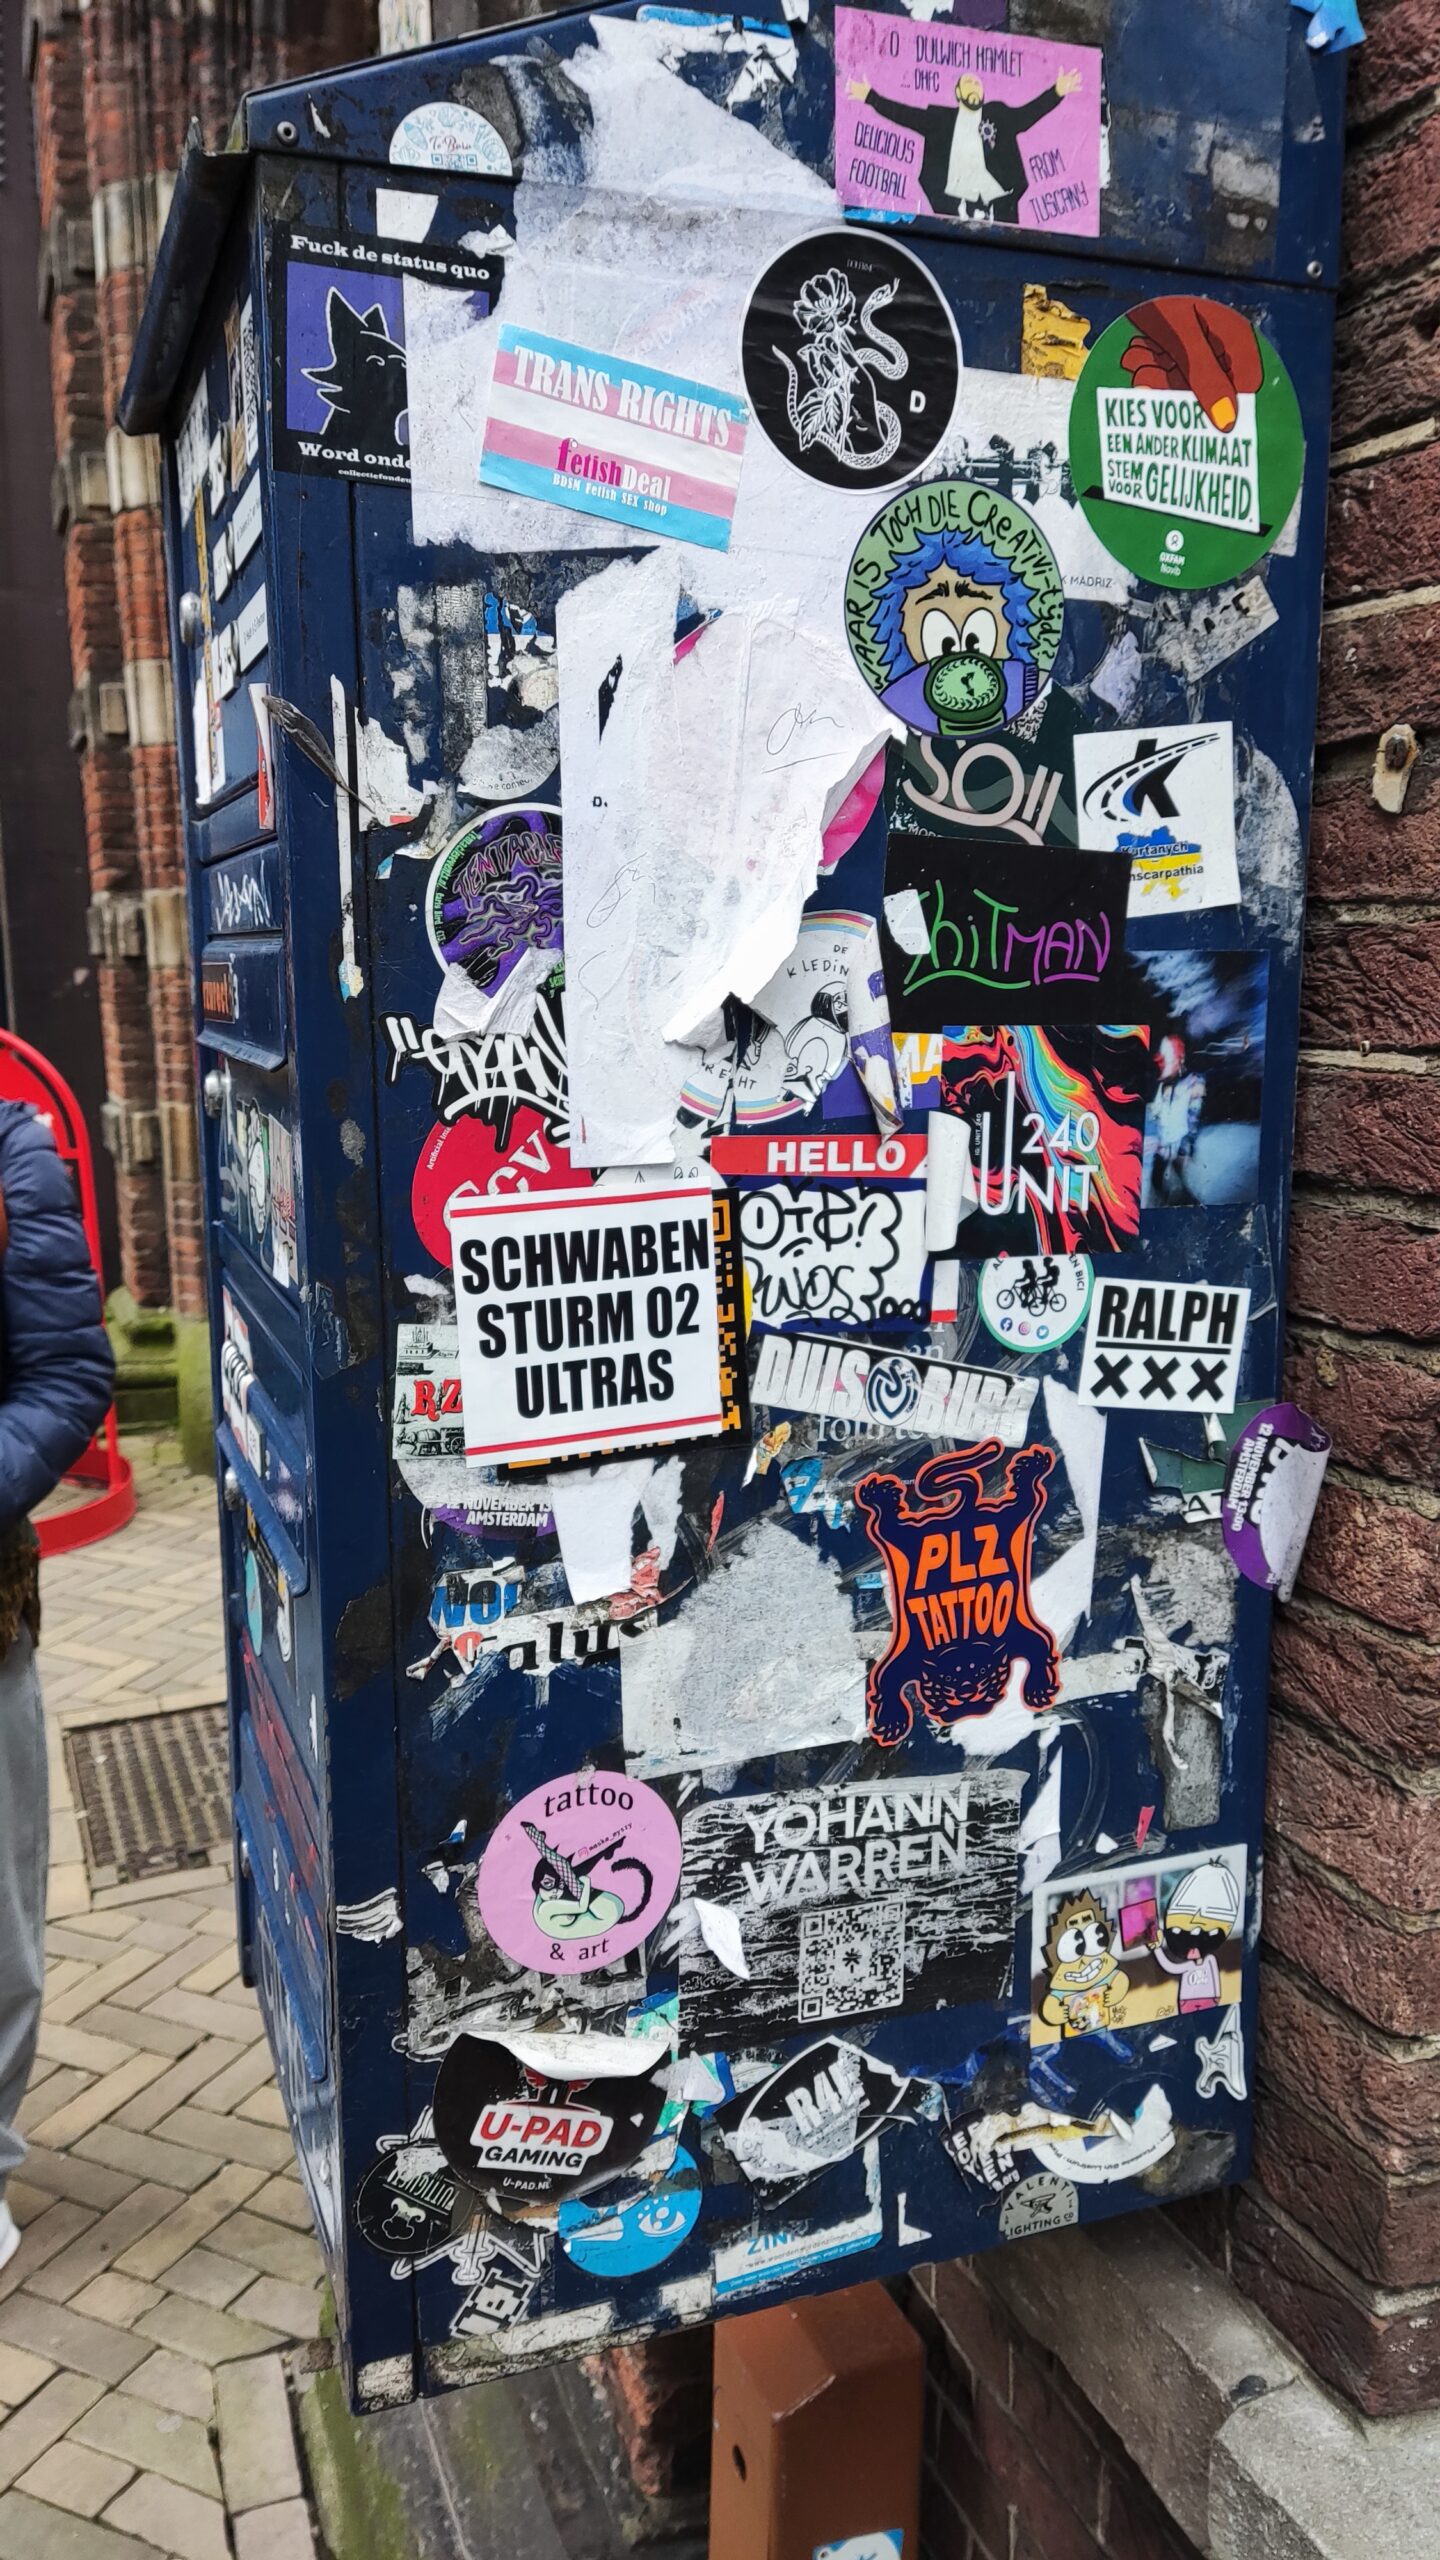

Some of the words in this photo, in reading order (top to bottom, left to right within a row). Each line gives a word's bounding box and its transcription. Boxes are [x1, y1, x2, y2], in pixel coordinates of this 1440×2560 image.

[916, 34, 970, 69] DULWICH
[976, 46, 1023, 78] HAMLET
[914, 68, 940, 92] DHFC
[854, 120, 915, 165] DELICIOUS
[848, 157, 907, 200] FOOTBALL
[1029, 148, 1066, 183] FROM
[1029, 180, 1089, 224] TUSCANY
[290, 234, 349, 258] Fuck
[352, 245, 378, 263] de
[381, 253, 448, 275] status
[451, 263, 490, 281] quo
[514, 345, 610, 412] TRANS
[617, 378, 732, 447] RIGHTS
[1105, 398, 1147, 428] KIES
[1151, 400, 1207, 430] VOOR
[298, 441, 360, 463] Word
[1107, 433, 1132, 454] EEN
[1136, 433, 1179, 459] ANDER
[1181, 434, 1252, 468] KLIMAAT
[1108, 459, 1143, 481] STEM
[553, 473, 580, 493] BDSM
[585, 482, 617, 503] Fetish
[621, 493, 639, 510] SEX
[643, 500, 667, 517] shop
[1108, 479, 1142, 499] VOOR
[1146, 462, 1254, 523] GELIJKHEID.
[870, 495, 922, 548] TOCH
[928, 489, 960, 528] DIE
[853, 558, 882, 589] IS
[1159, 552, 1185, 566] OXFAM
[1070, 576, 1113, 589] MADRIZ
[847, 598, 887, 691] WAAR
[833, 944, 848, 955] DE
[1022, 1111, 1100, 1154] 240
[427, 1138, 444, 1170] Artificial
[767, 1140, 906, 1173] HELLO
[460, 1218, 710, 1295] SCHWABEN
[1074, 1270, 1085, 1291] BICI
[477, 1290, 635, 1359] STURM
[646, 1283, 700, 1339] 02
[1097, 1285, 1240, 1345] RALPH
[515, 1349, 675, 1419] ULTRAS
[1258, 1423, 1274, 1437] 12
[1227, 1437, 1256, 1510] AMSTERDAM
[1240, 1437, 1268, 1500] NOVEMBER
[464, 1499, 535, 1512] NOVEMBER
[466, 1510, 548, 1527] AMSTERDAM
[1231, 1500, 1249, 1532] 13:00
[915, 1524, 1009, 1590] PLZ
[907, 1580, 1014, 1651] TATTOO
[544, 1783, 634, 1818] tattoo
[744, 1781, 970, 1854] YOHANN
[741, 1825, 967, 1904] WARREN
[550, 1943, 566, 1961] &
[578, 1938, 610, 1961] art
[480, 2111, 602, 2148] U-PAD
[485, 2146, 583, 2168] GAMING
[1005, 2176, 1074, 2211] VALENTI
